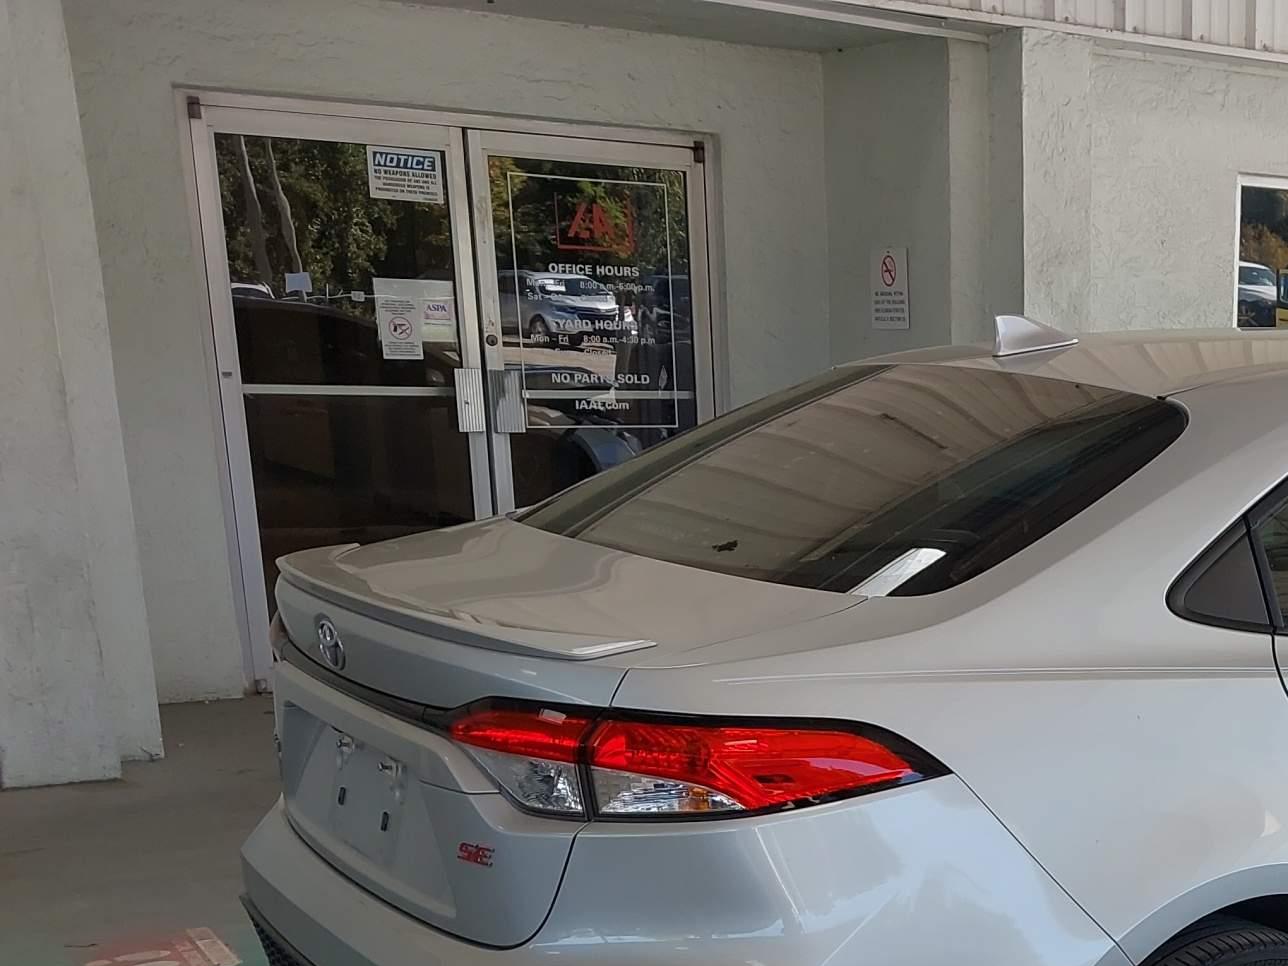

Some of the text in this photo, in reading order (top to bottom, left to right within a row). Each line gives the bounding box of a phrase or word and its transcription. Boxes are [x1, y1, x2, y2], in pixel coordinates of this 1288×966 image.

[374, 152, 434, 170] NOTICE
[383, 169, 411, 177] WEAPONS
[548, 263, 640, 277] OFFICE HOURS
[426, 303, 448, 312] ASPA
[558, 319, 638, 330] YARD HOURS
[530, 334, 550, 343] Mon
[583, 335, 600, 343] 8:00
[552, 373, 570, 383] NO
[617, 374, 650, 384] SOLD
[457, 842, 495, 867] SE
